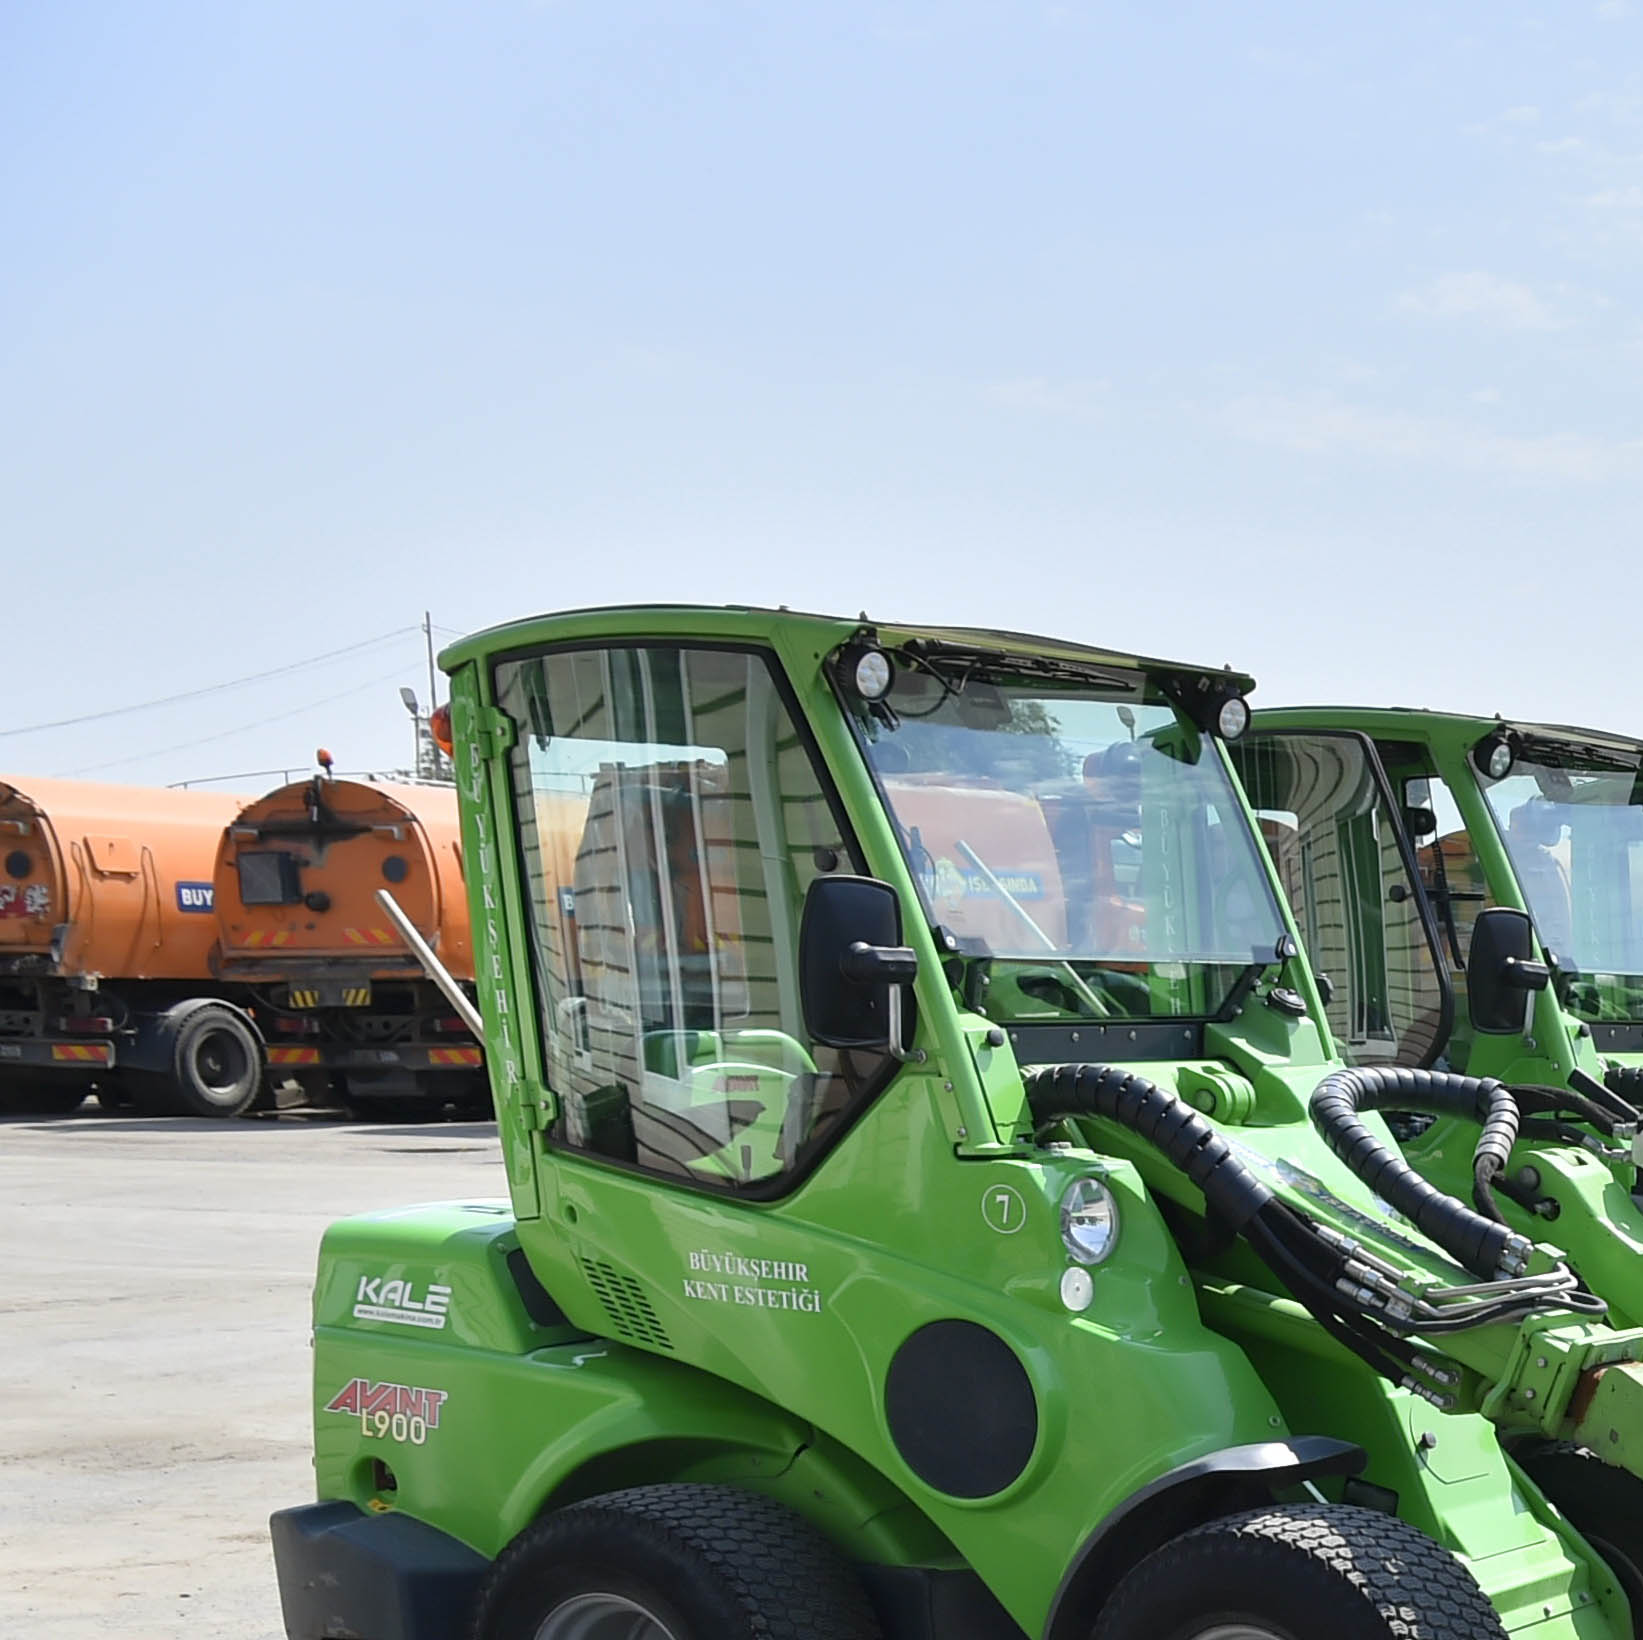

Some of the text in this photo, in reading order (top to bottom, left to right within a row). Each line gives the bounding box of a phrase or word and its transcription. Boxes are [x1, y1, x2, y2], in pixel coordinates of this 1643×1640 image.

[356, 1275, 452, 1314] KALE
[682, 1279, 822, 1313] KENT ESTETİĞİ
[323, 1377, 449, 1429] AVANT
[361, 1407, 427, 1445] L900
